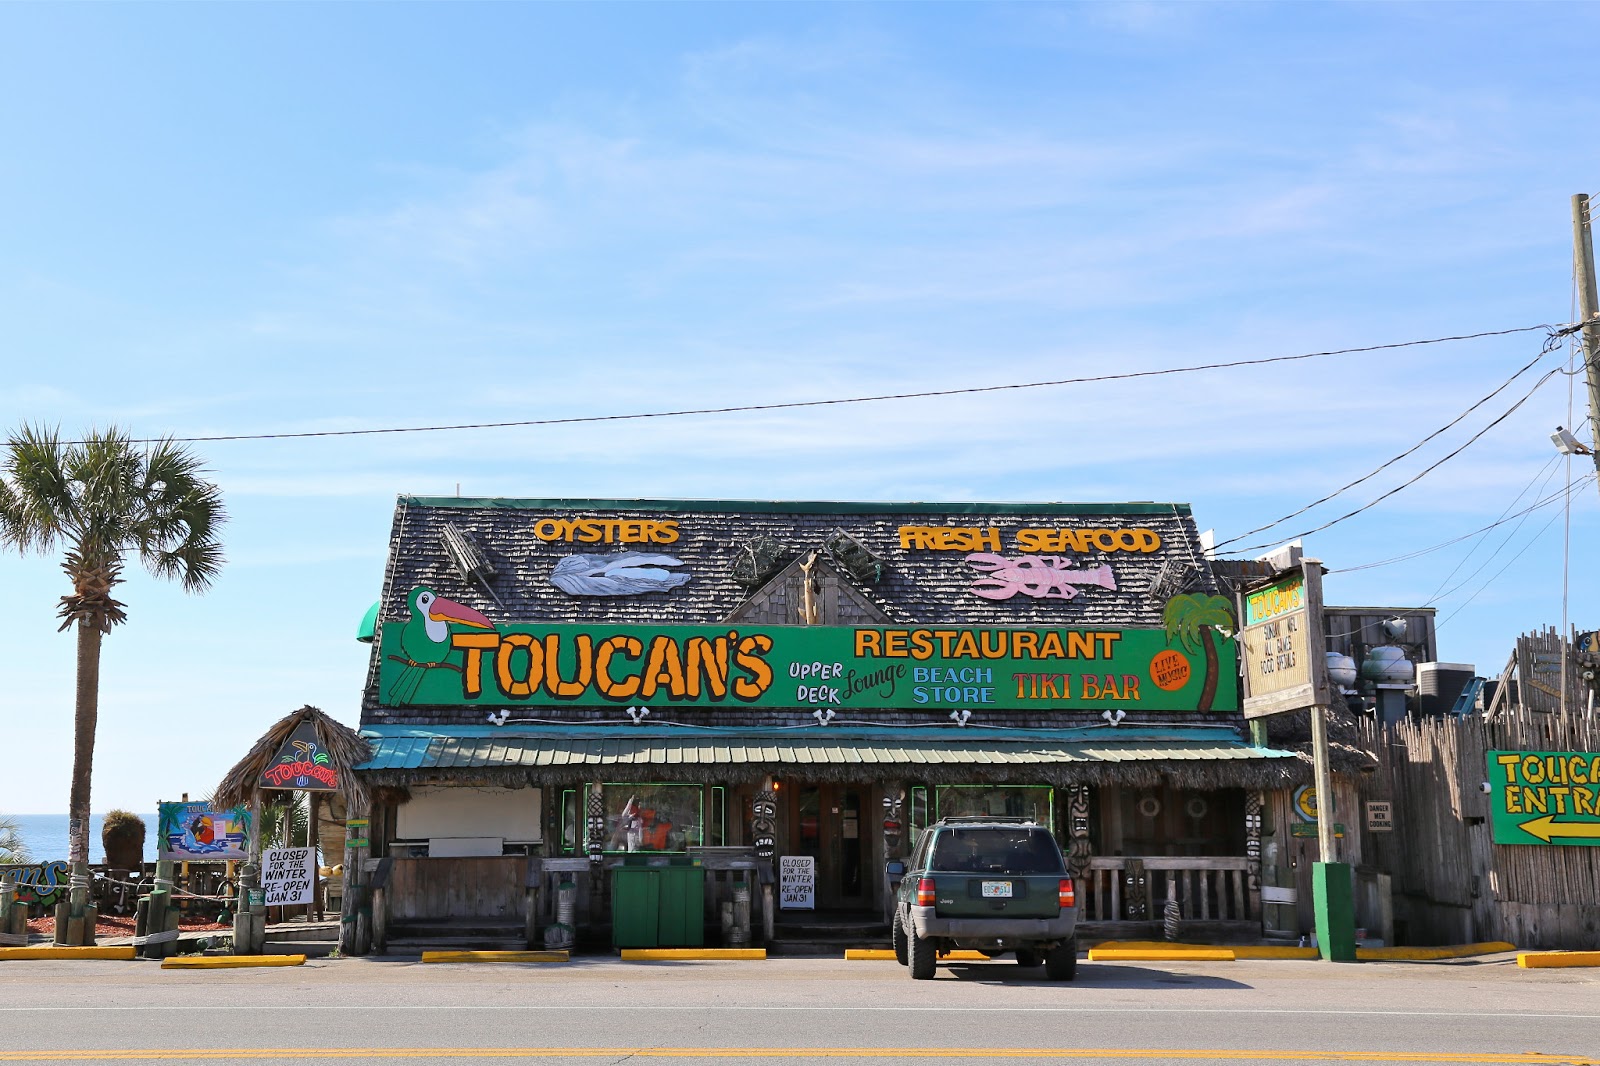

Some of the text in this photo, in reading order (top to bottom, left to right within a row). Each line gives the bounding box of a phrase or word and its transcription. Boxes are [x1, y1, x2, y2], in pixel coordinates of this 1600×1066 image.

[533, 517, 681, 545] OYSTERS
[898, 526, 1162, 553] FRESH SEAFOOD
[854, 628, 1122, 661] RESTAURANT
[451, 630, 775, 702] TOUCAN'S
[789, 661, 843, 680] UPPER
[1154, 653, 1180, 674] LIVE
[1261, 657, 1275, 675] FOOD
[842, 663, 906, 700] Lounge
[912, 666, 993, 684] BEACH
[1157, 665, 1188, 687] MUSIC
[797, 685, 842, 705] DECK
[912, 686, 996, 704] STORE
[1011, 673, 1141, 701] TIKI BAR
[1369, 804, 1389, 812] DANGER
[1370, 820, 1391, 828] COOKING
[269, 850, 309, 862] CLOSED
[269, 860, 305, 870] FOR THE
[782, 859, 811, 867] CLOSED
[265, 869, 307, 880] WINTER
[782, 875, 812, 883] WINTER
[264, 879, 311, 893] RE-OPEN
[781, 884, 814, 893] RE-OPEN
